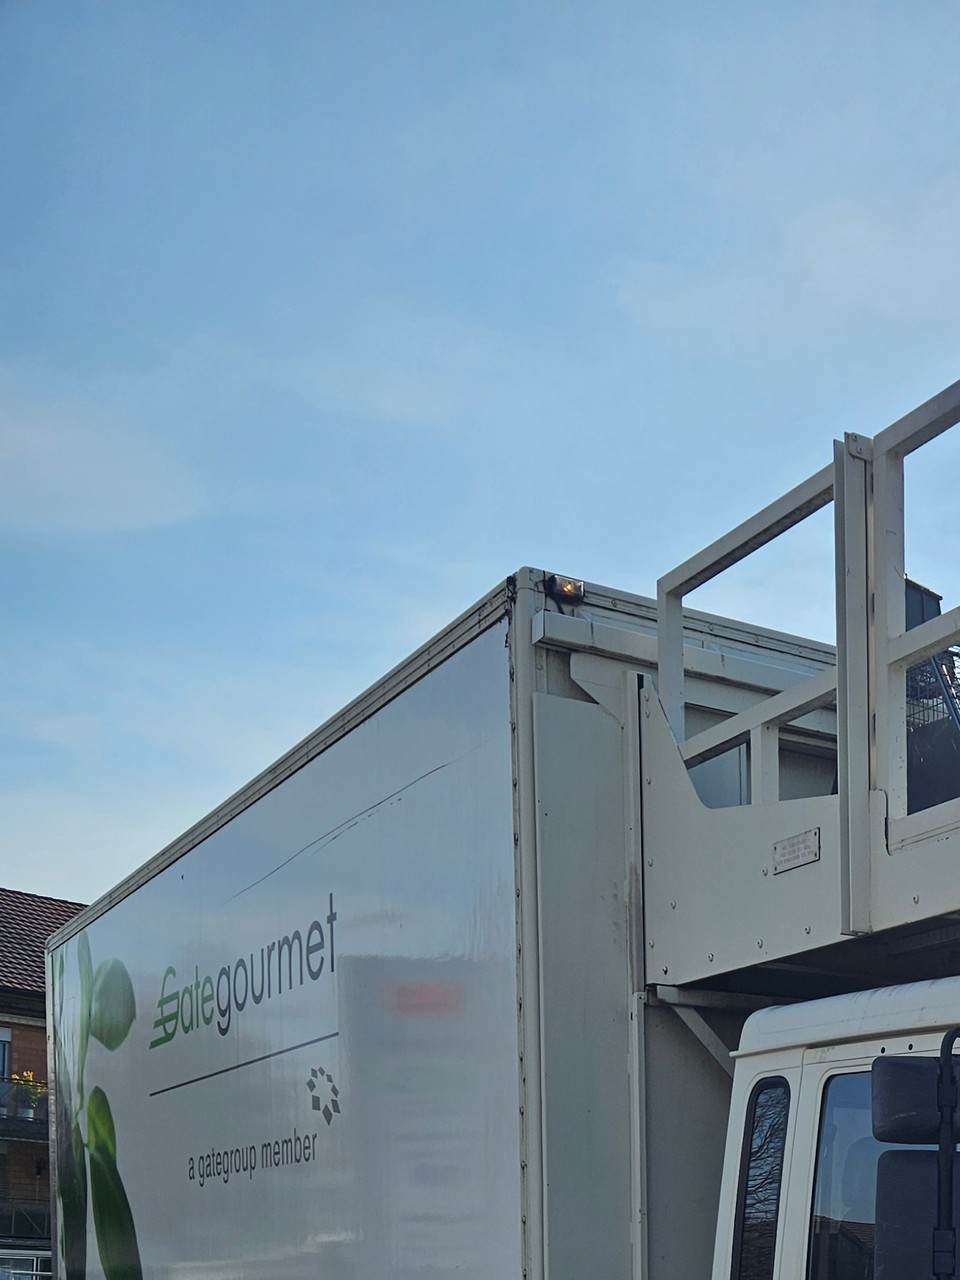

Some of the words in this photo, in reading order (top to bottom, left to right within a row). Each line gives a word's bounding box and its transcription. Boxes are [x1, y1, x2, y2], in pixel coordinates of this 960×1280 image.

[188, 1157, 195, 1180] a
[198, 1147, 257, 1187] gategroup
[261, 1128, 317, 1169] member
